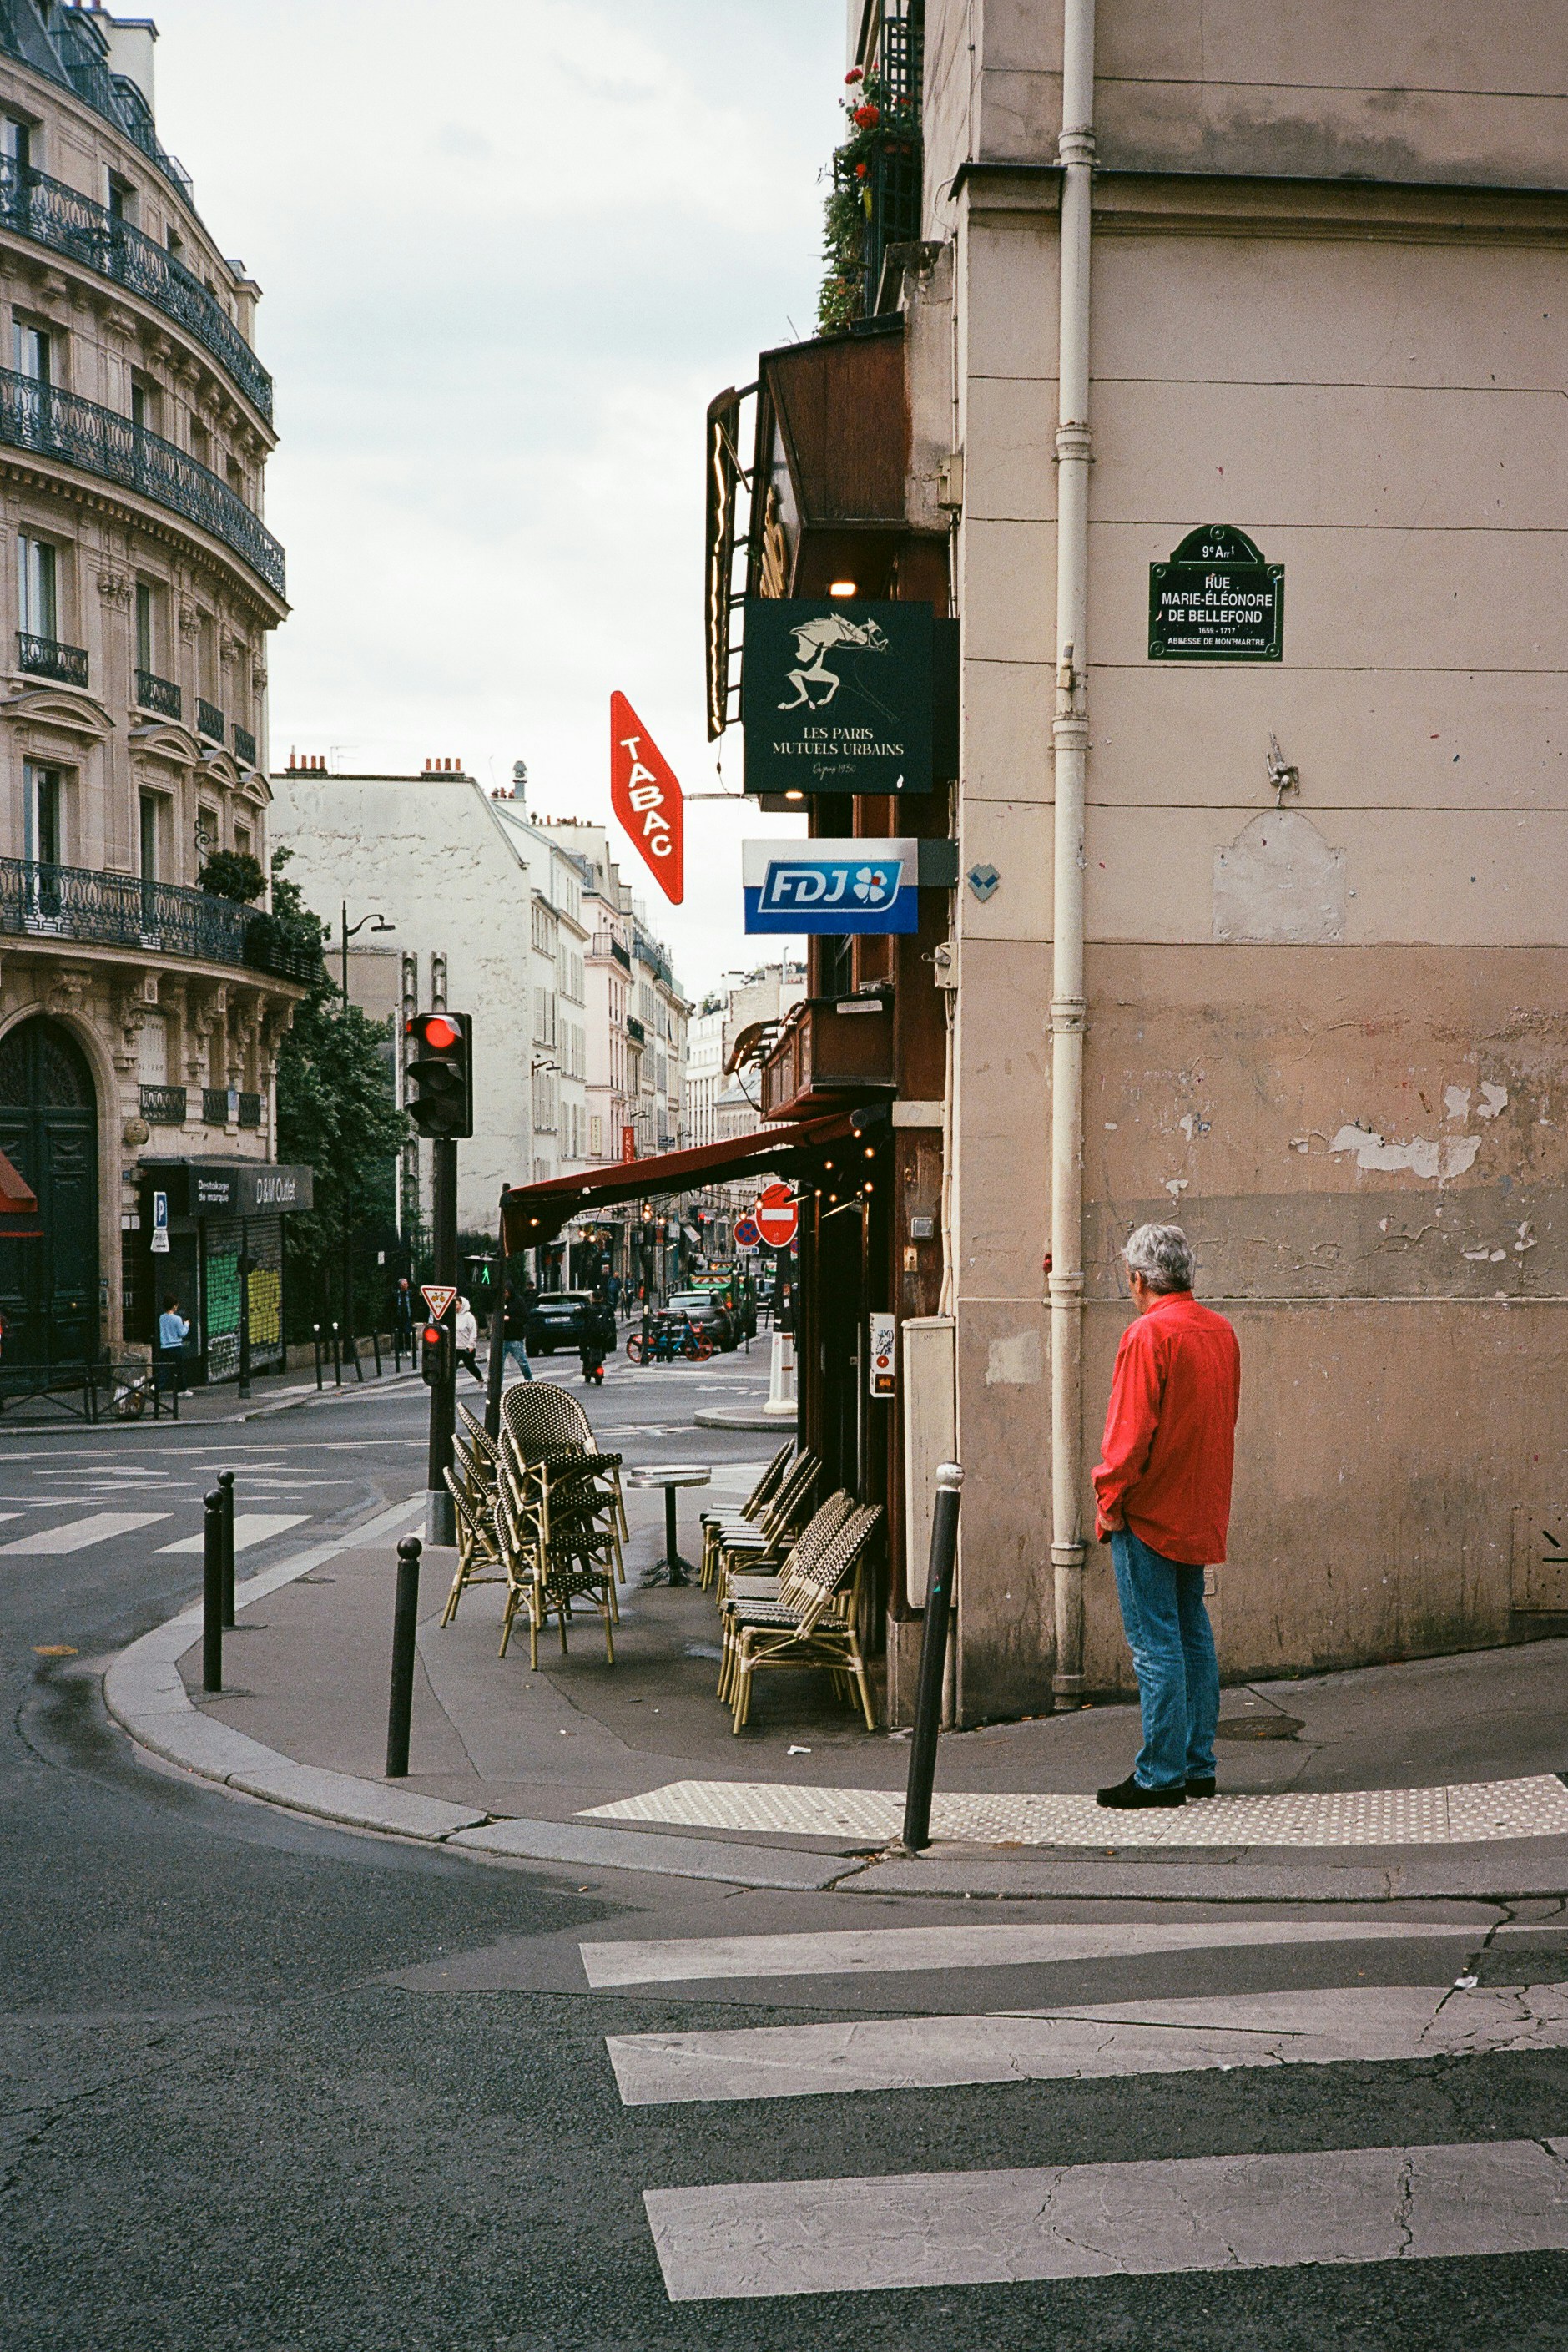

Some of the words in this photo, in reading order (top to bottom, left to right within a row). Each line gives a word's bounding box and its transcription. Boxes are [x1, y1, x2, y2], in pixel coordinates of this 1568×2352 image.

[1205, 576, 1231, 589] RUE
[1162, 590, 1273, 607] MARIE-ÉLÉONORE
[1168, 609, 1186, 622] DE
[1188, 610, 1263, 623] BELLEFOND
[1215, 638, 1265, 646] MONTMARTRE
[804, 727, 829, 739] LES
[833, 728, 874, 740] PARIS
[773, 742, 839, 755] MUTUELS
[843, 743, 905, 756] URBAINS
[620, 736, 673, 857] TABAC
[770, 870, 849, 903] FDJ
[198, 1179, 229, 1193] Destokage
[199, 1191, 206, 1202] de
[207, 1193, 229, 1204] marque
[159, 1199, 164, 1222] P
